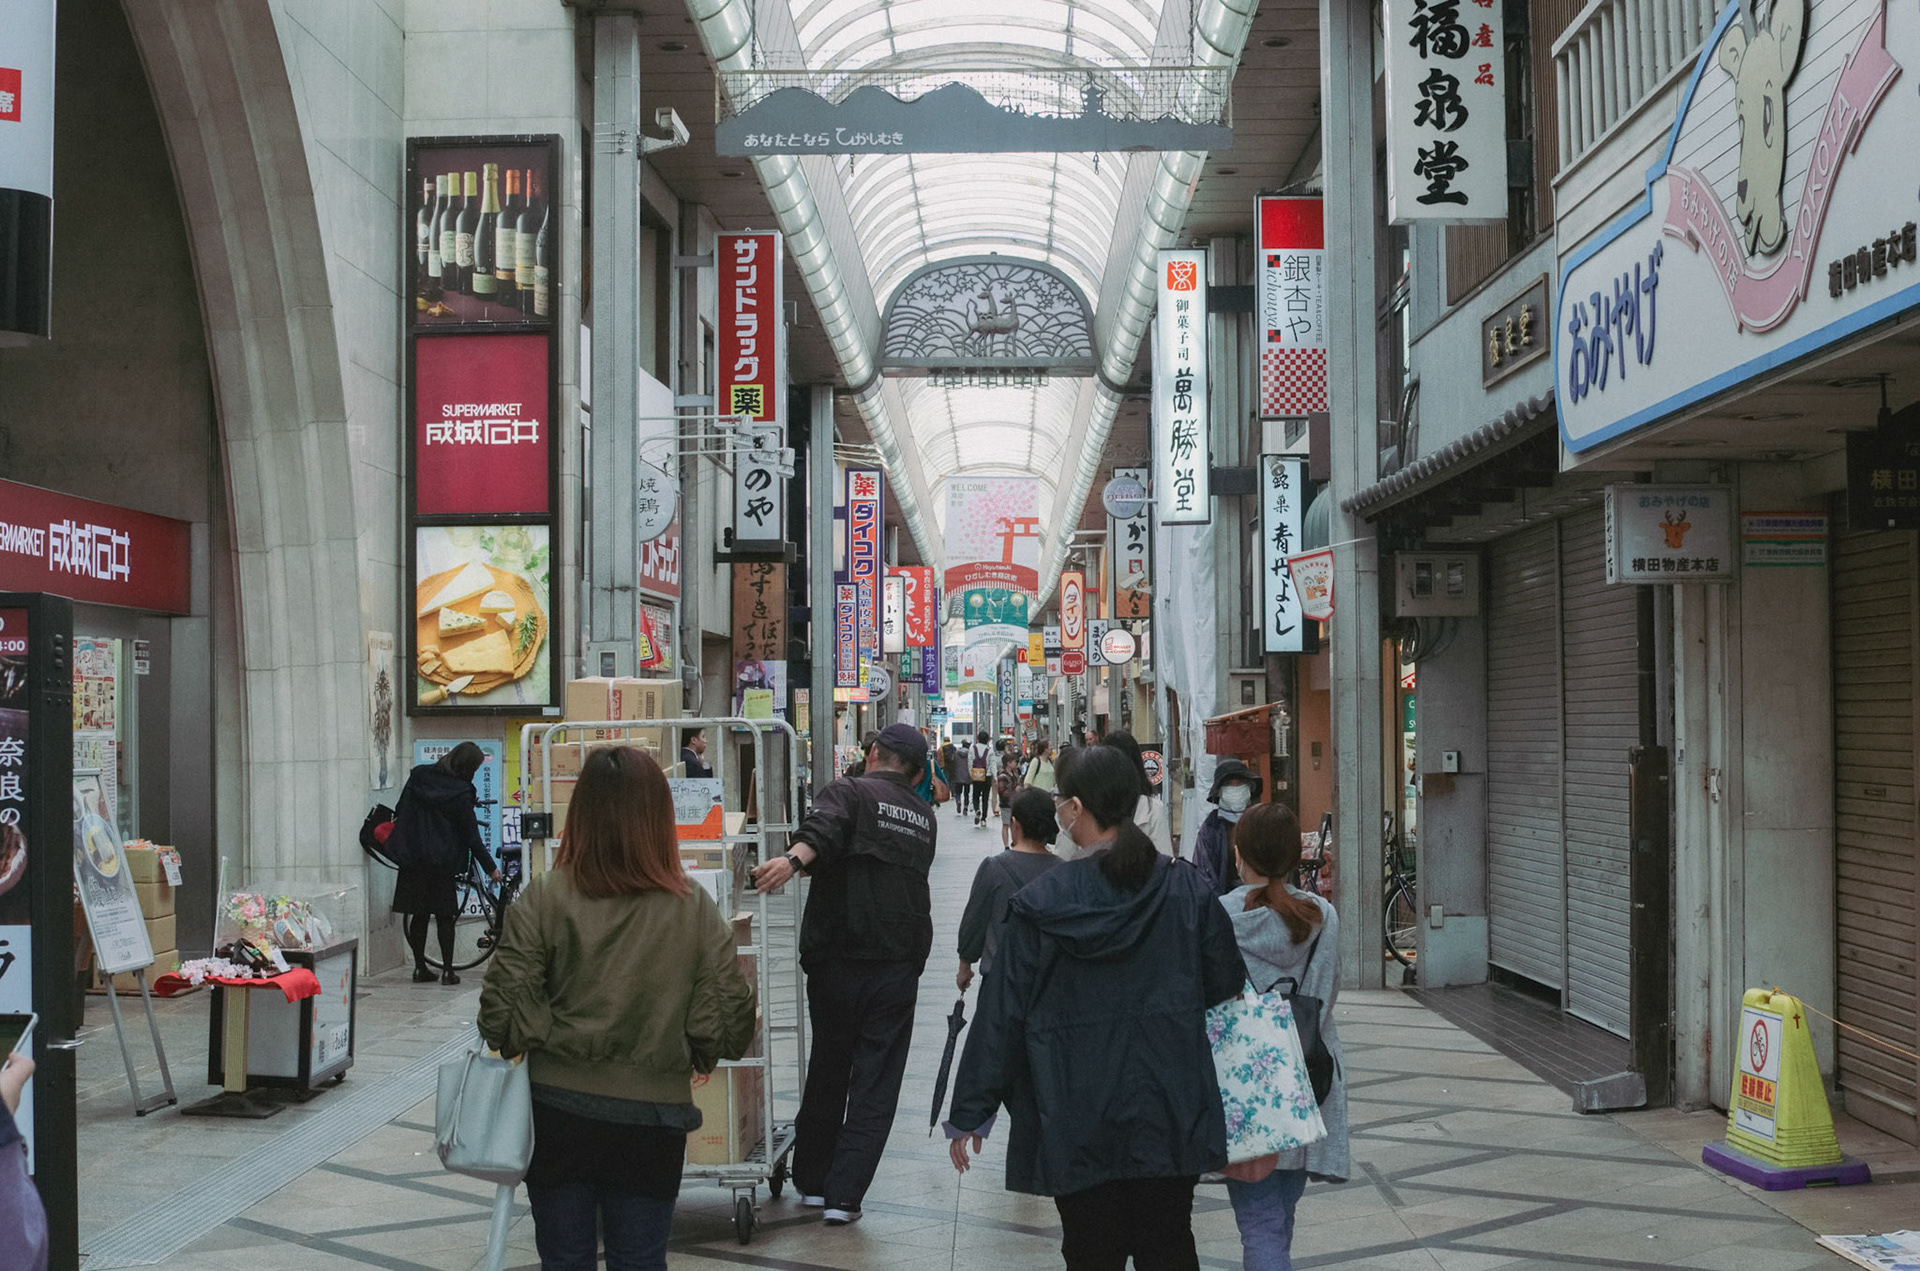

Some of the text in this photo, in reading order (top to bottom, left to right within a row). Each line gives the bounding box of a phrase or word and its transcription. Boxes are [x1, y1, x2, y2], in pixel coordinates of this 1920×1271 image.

[1408, 0, 1470, 206] 福泉堂
[744, 127, 903, 146] あなたとなら ひがしむき
[1681, 180, 1739, 294] おみやげの店
[734, 238, 760, 381] サンドラッグ
[1264, 269, 1282, 328] ichouya
[1283, 254, 1311, 342] 銀杏や
[1569, 239, 1663, 404] おみやげ
[1176, 299, 1189, 360] 御菓子司
[442, 403, 522, 417] SUPERMARKET
[734, 388, 760, 414] 薬
[426, 419, 539, 445] 成城石井
[1171, 366, 1198, 511] 萬勝堂
[855, 473, 875, 496] 薬
[951, 484, 988, 492] WELCOME
[1639, 495, 1710, 508] おみやげの店
[50, 519, 130, 582] 成城石井
[854, 503, 875, 576] ダイコク
[1632, 558, 1719, 572] 横田物産本店
[1271, 522, 1296, 636] 青丹よし
[1066, 593, 1078, 632] ダイソー
[839, 671, 856, 681] 免税
[0, 736, 25, 826] 奈良の
[877, 801, 930, 831] FUKUYAMA
